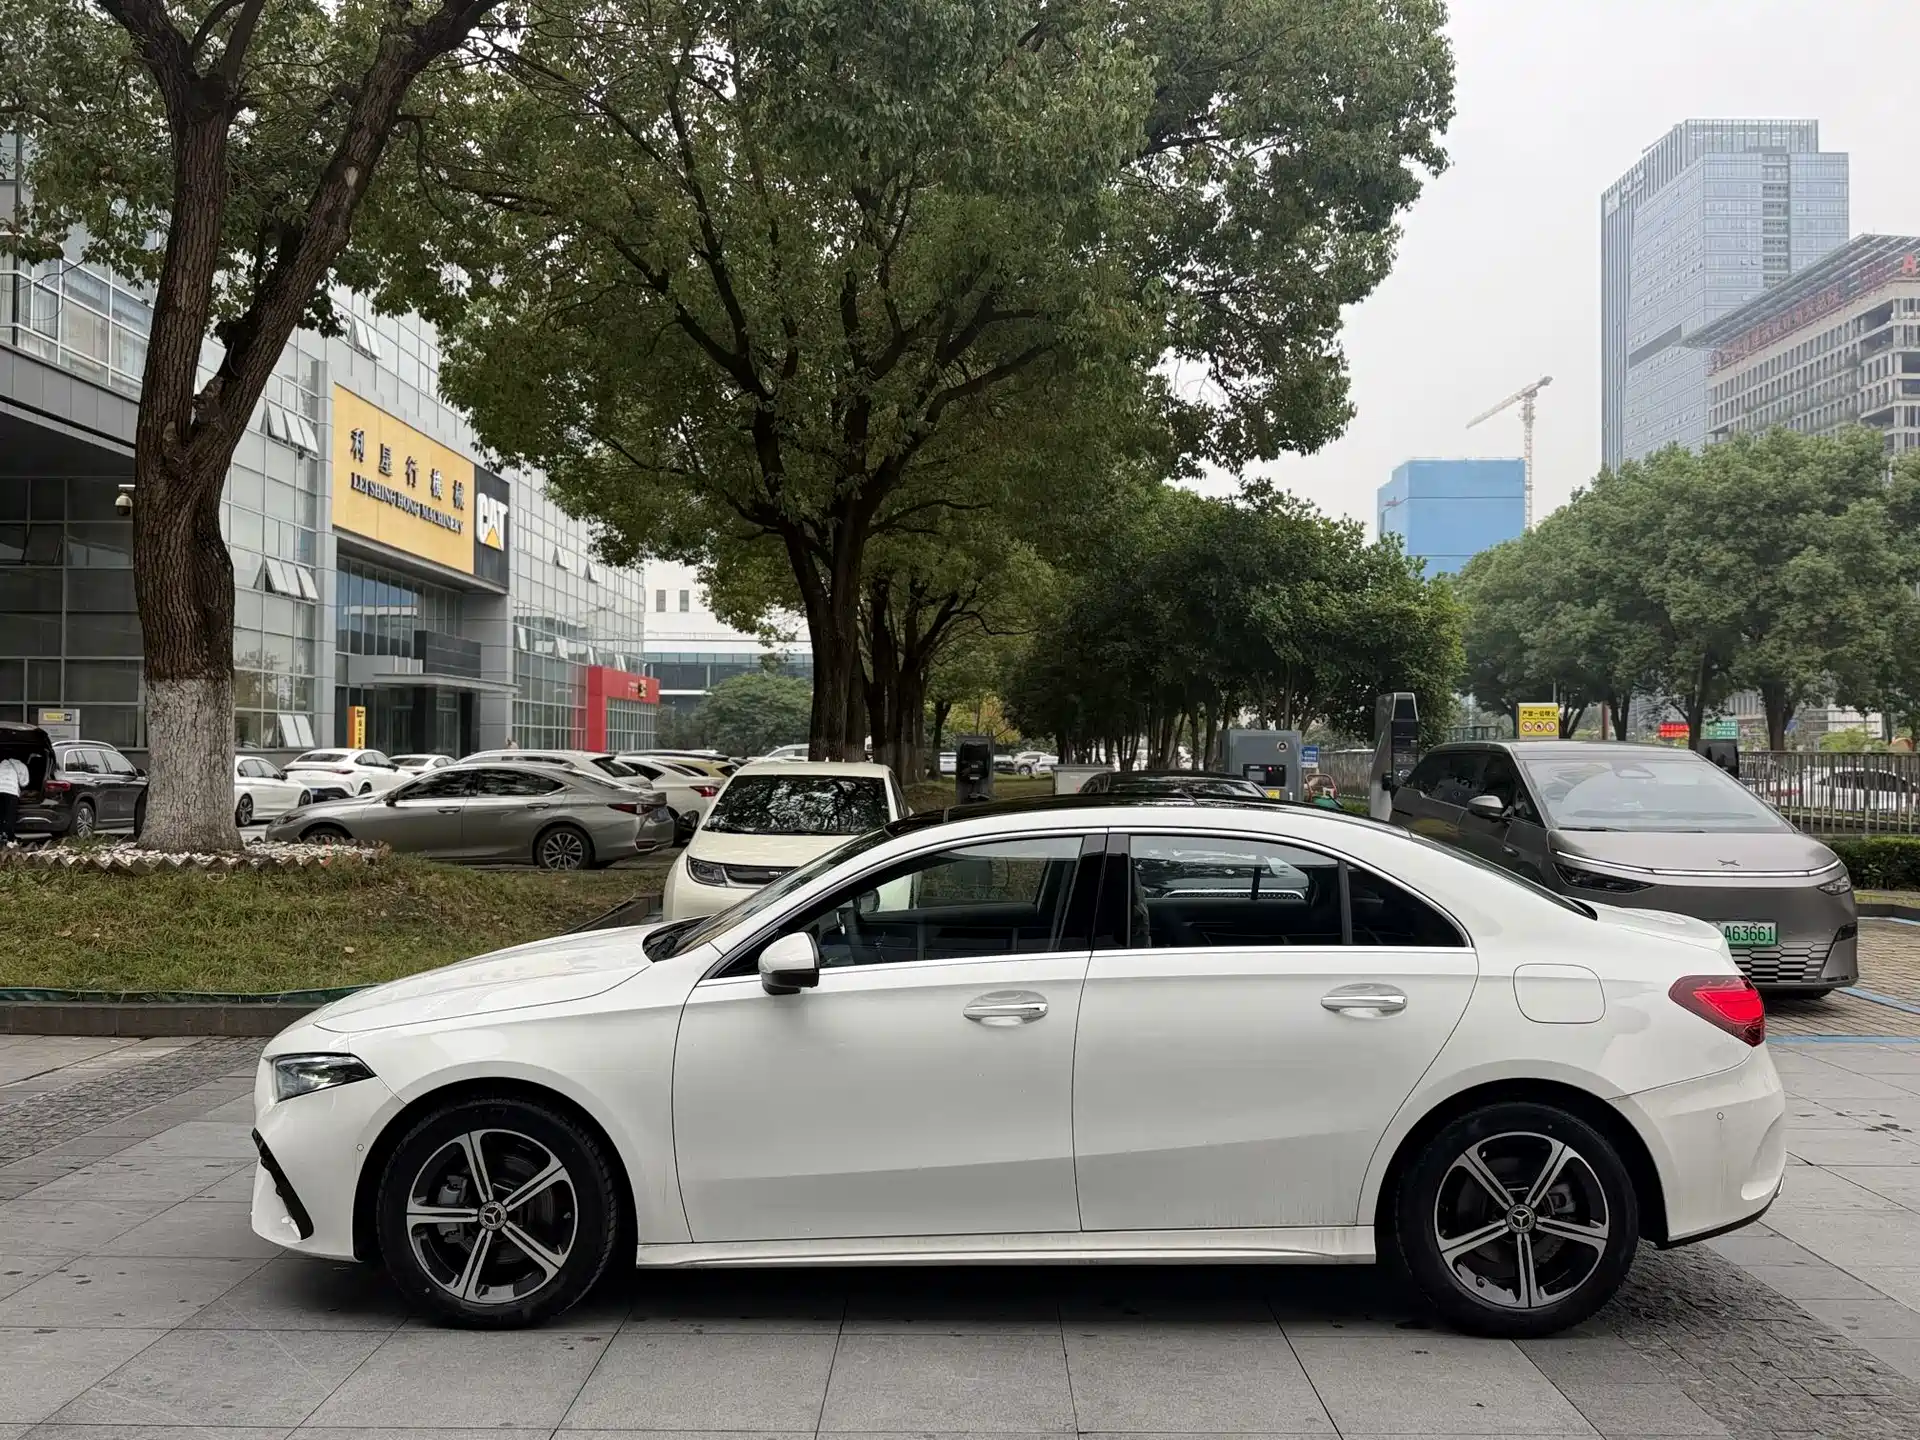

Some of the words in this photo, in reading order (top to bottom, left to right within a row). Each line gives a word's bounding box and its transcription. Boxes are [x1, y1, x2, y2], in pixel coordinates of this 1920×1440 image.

[351, 472, 368, 495] LEI
[368, 480, 397, 506] SHING
[396, 492, 420, 518] HONG
[420, 503, 464, 535] MACHINERY
[476, 492, 509, 552] CAT
[1724, 925, 1774, 942] A63661
